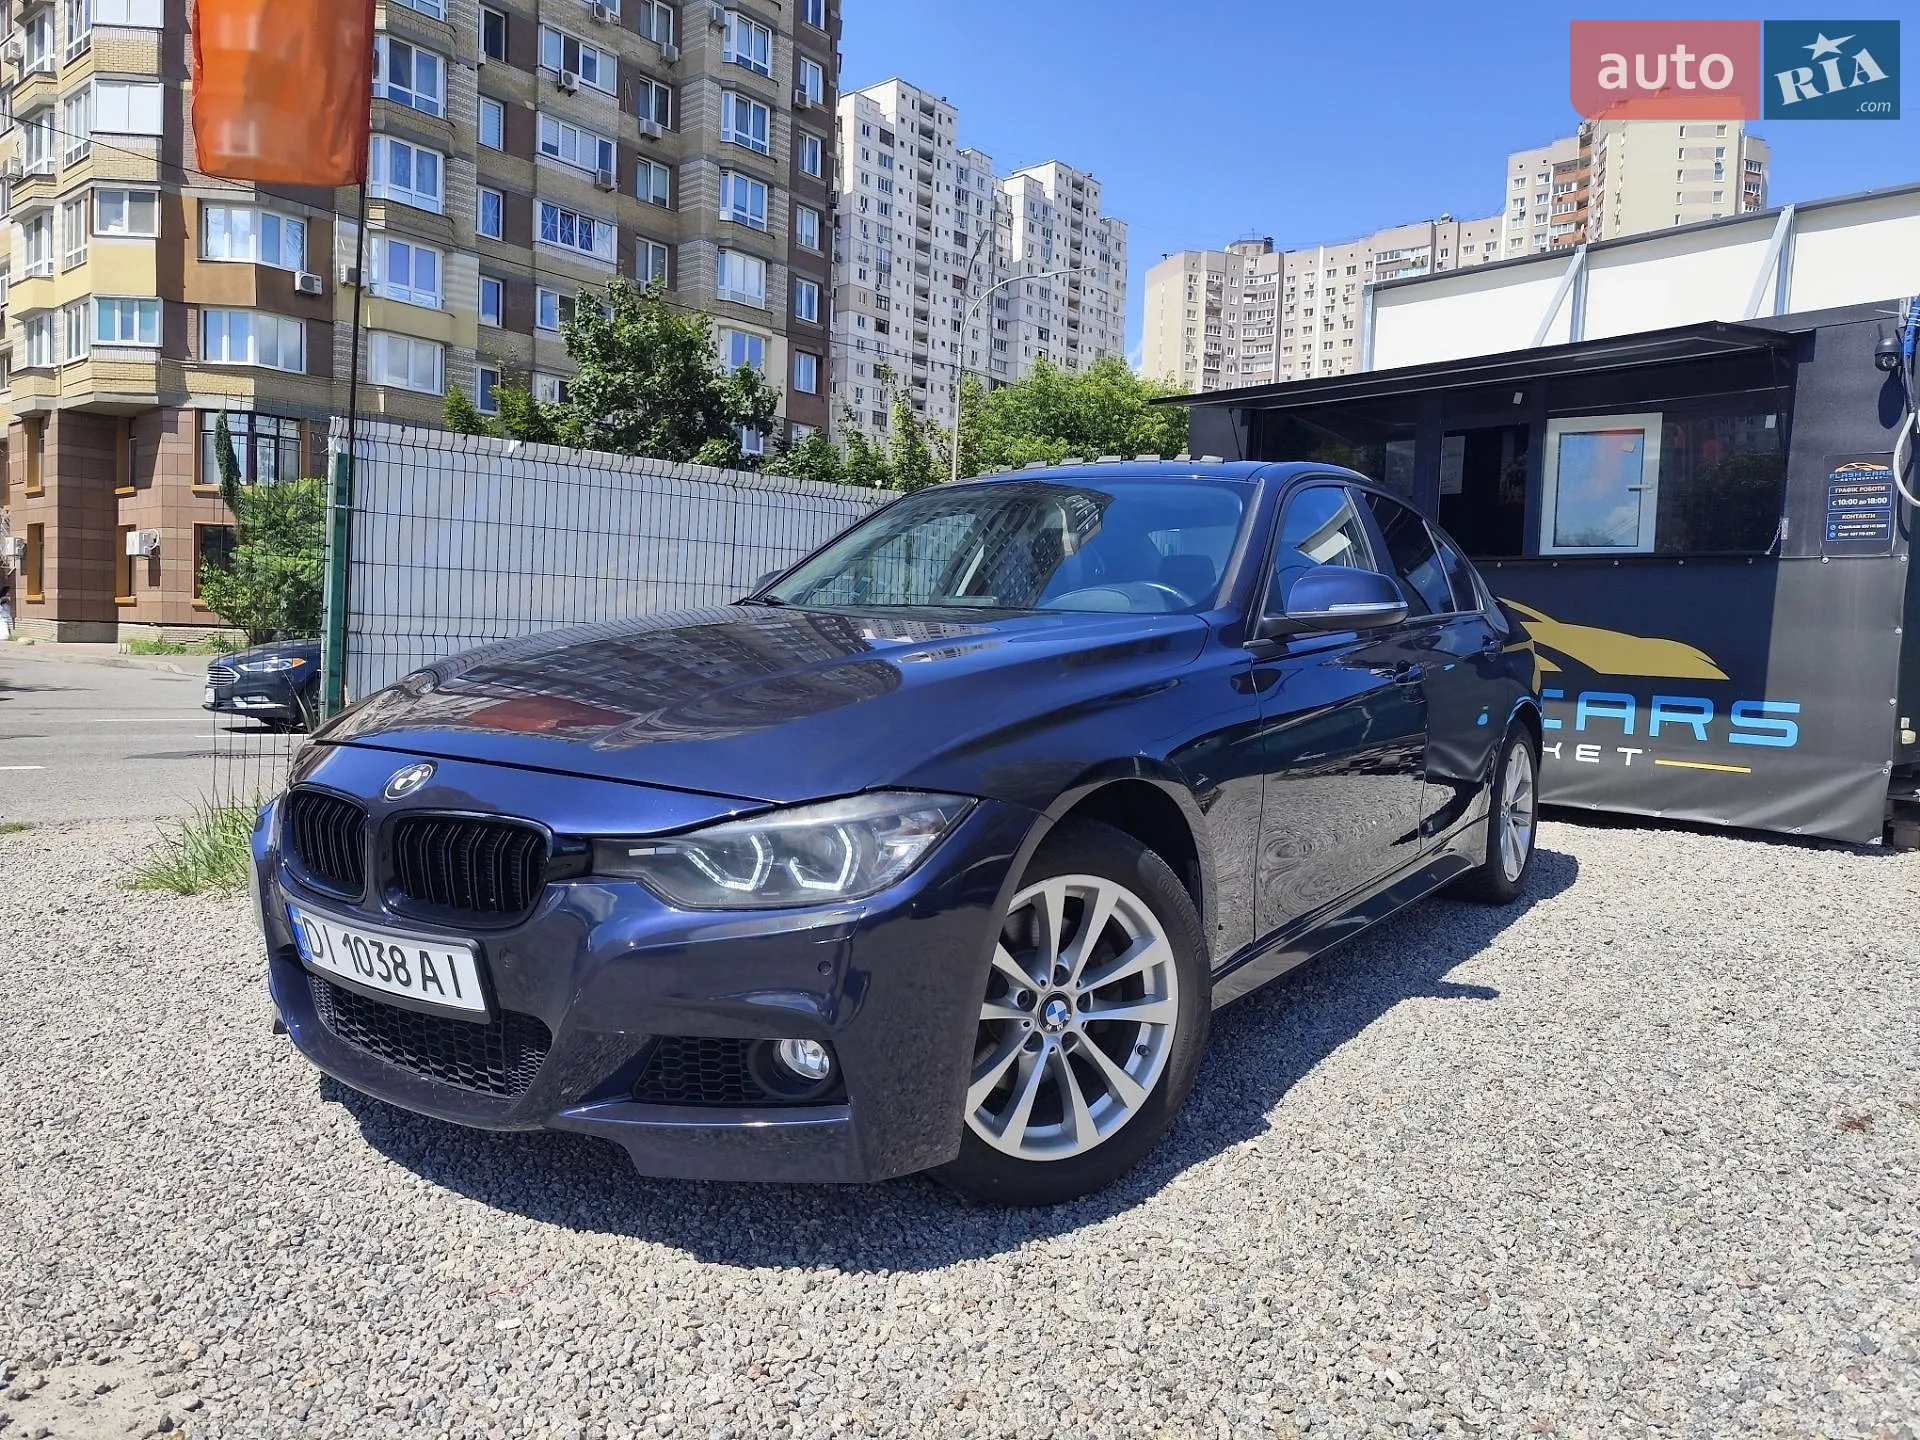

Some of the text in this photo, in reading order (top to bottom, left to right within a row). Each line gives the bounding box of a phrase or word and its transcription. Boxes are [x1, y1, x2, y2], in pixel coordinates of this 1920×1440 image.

[302, 916, 463, 999] DI 1038 AI
